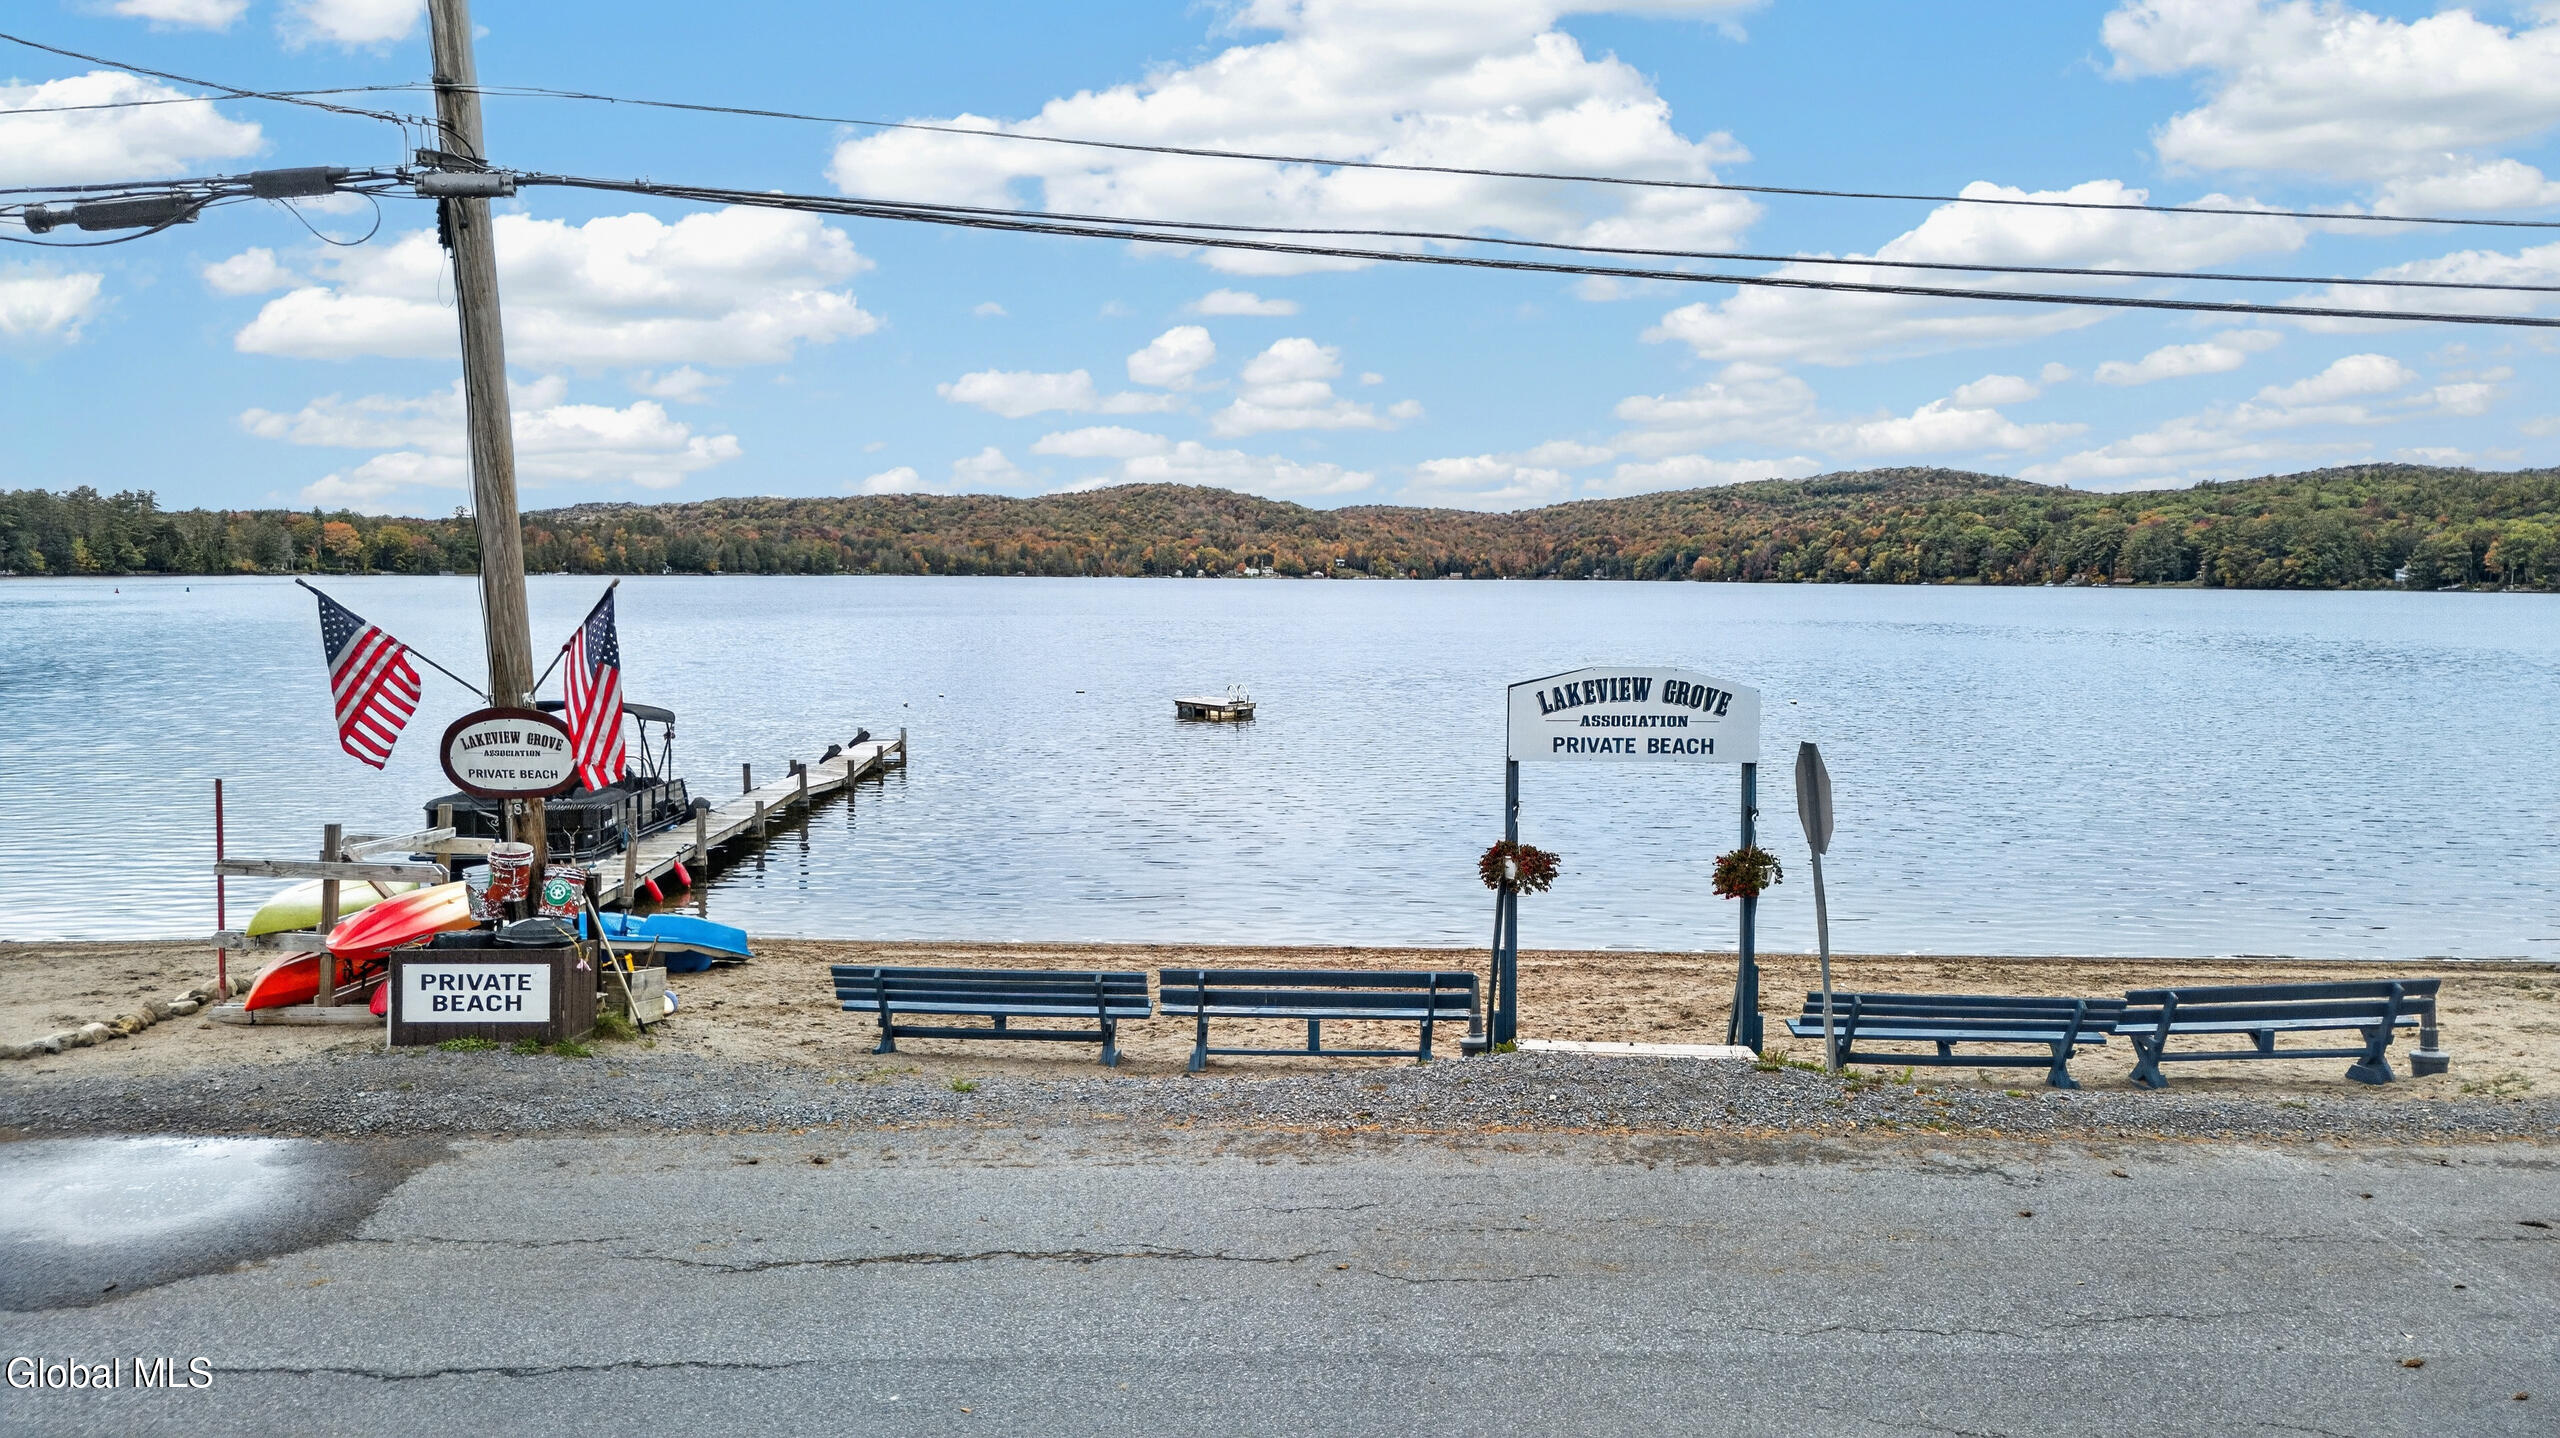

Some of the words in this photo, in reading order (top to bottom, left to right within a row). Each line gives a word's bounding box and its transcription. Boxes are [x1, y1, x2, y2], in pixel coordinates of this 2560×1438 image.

[1536, 676, 1653, 716] LAKEVIEW
[1662, 679, 1733, 717] GROVE
[1580, 715, 1689, 728] ASSOCIATION
[460, 731, 521, 751] LAKEVIEW
[527, 732, 564, 751] GROVE
[1553, 737, 1636, 754] PRIVATE
[1647, 737, 1714, 755] BEACH
[468, 769, 516, 779] PRIVATE
[520, 769, 559, 779] BEACH
[421, 974, 532, 991] PRIVATE
[432, 994, 522, 1012] BEACH
